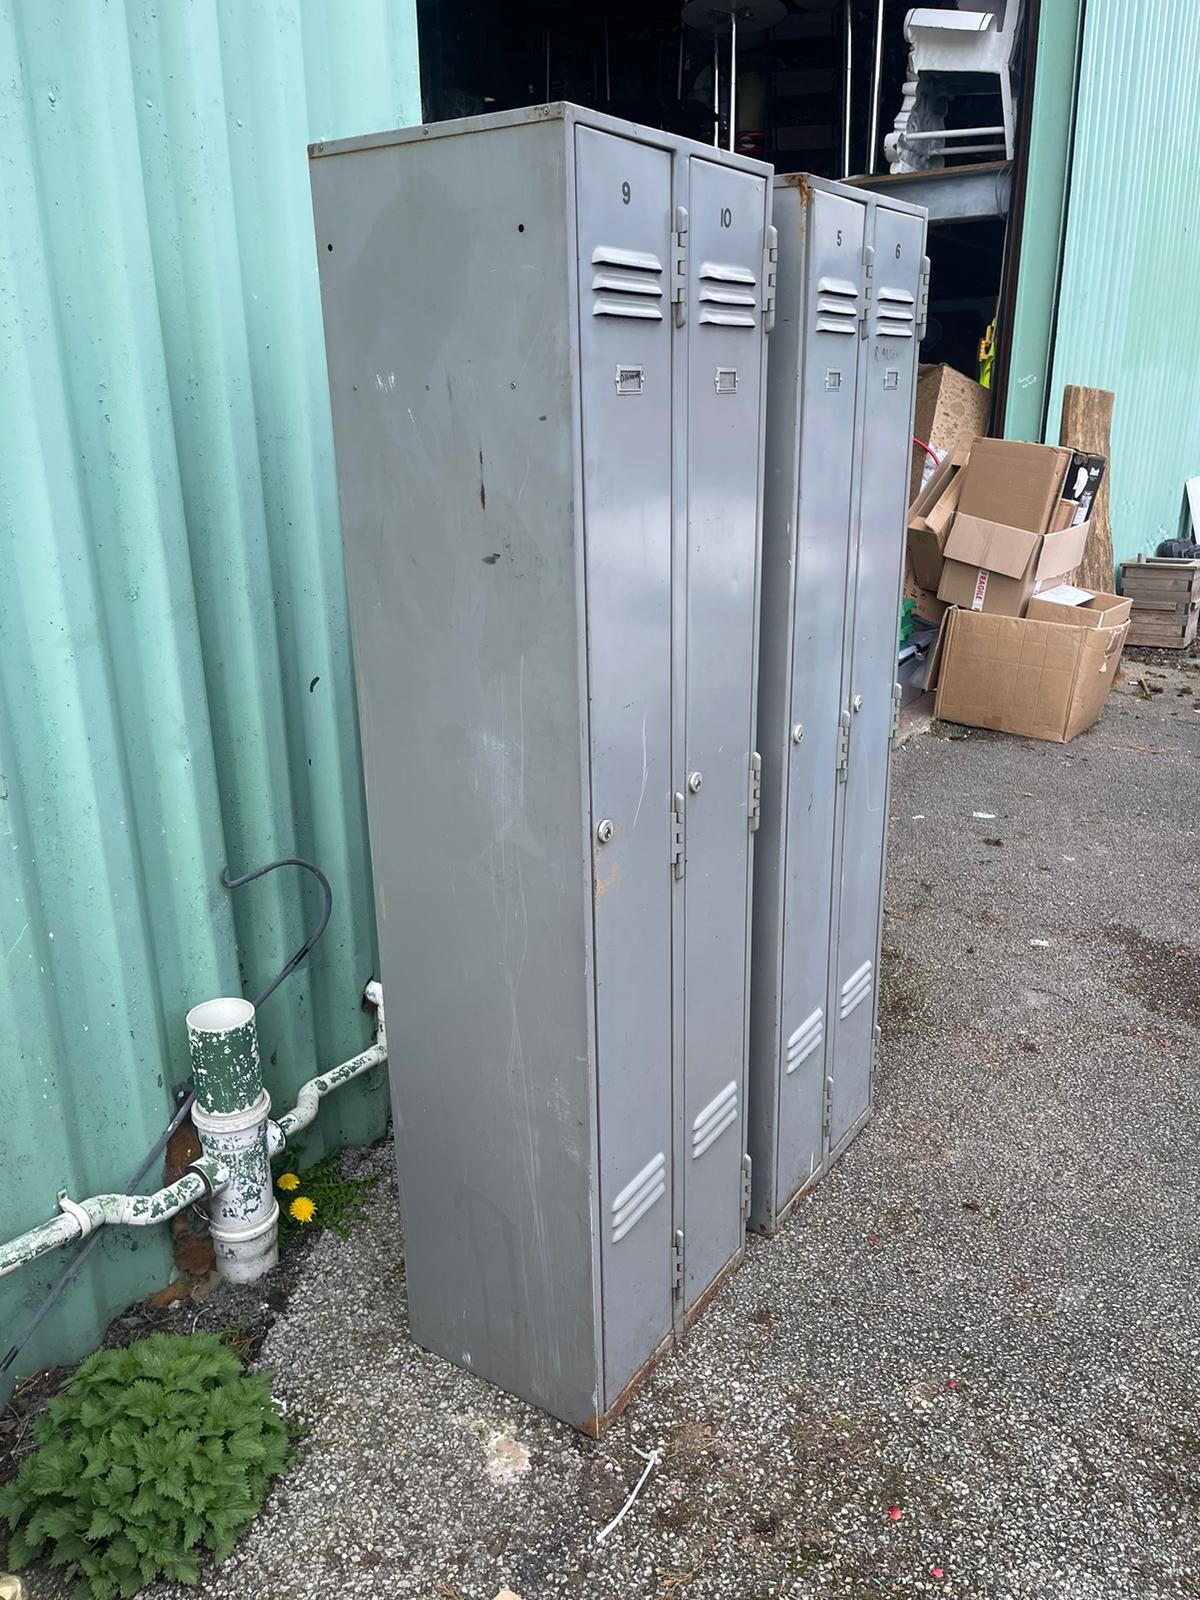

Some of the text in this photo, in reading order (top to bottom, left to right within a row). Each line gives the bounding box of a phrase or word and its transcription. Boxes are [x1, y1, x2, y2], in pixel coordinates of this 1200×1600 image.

[621, 181, 632, 206] 9
[720, 207, 732, 229] 10
[836, 229, 843, 247] 5
[895, 243, 902, 260] 6
[975, 569, 988, 600] FRAGILE
